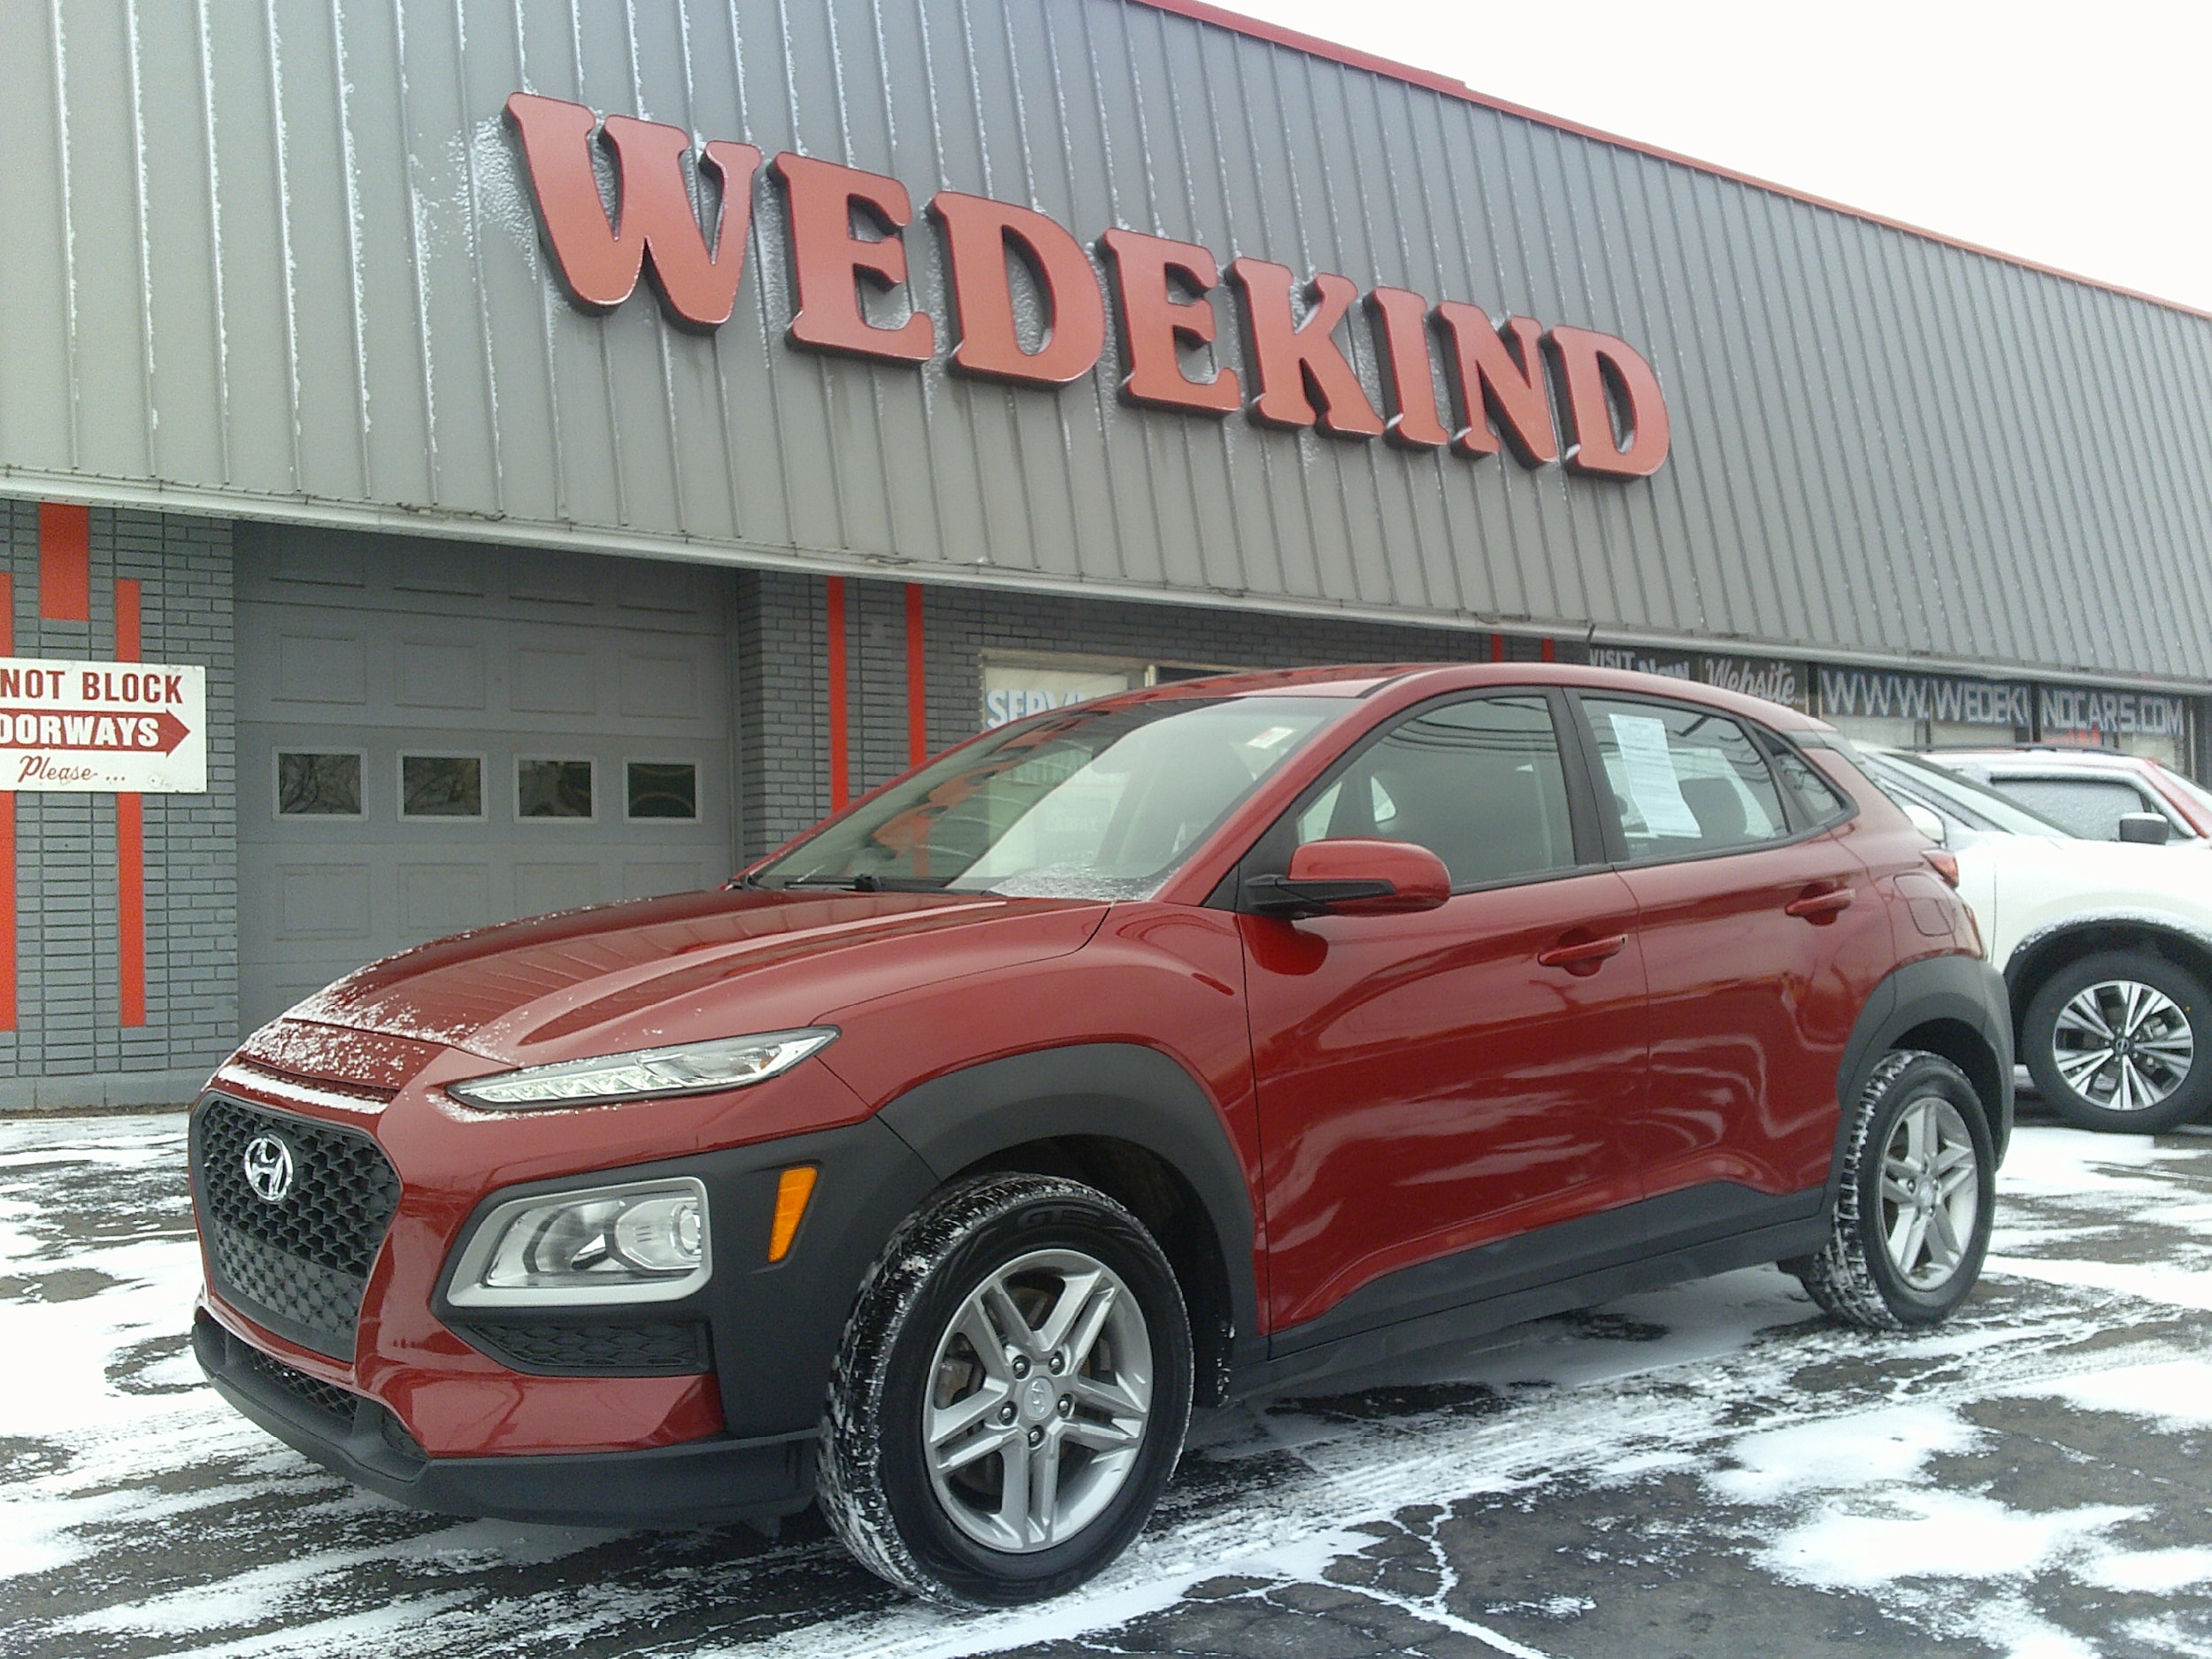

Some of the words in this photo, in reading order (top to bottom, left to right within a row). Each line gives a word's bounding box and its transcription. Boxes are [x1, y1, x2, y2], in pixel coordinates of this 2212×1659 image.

[504, 92, 1671, 481] WEDEKIND
[0, 669, 65, 700] NOT
[82, 672, 183, 704] BLOCK
